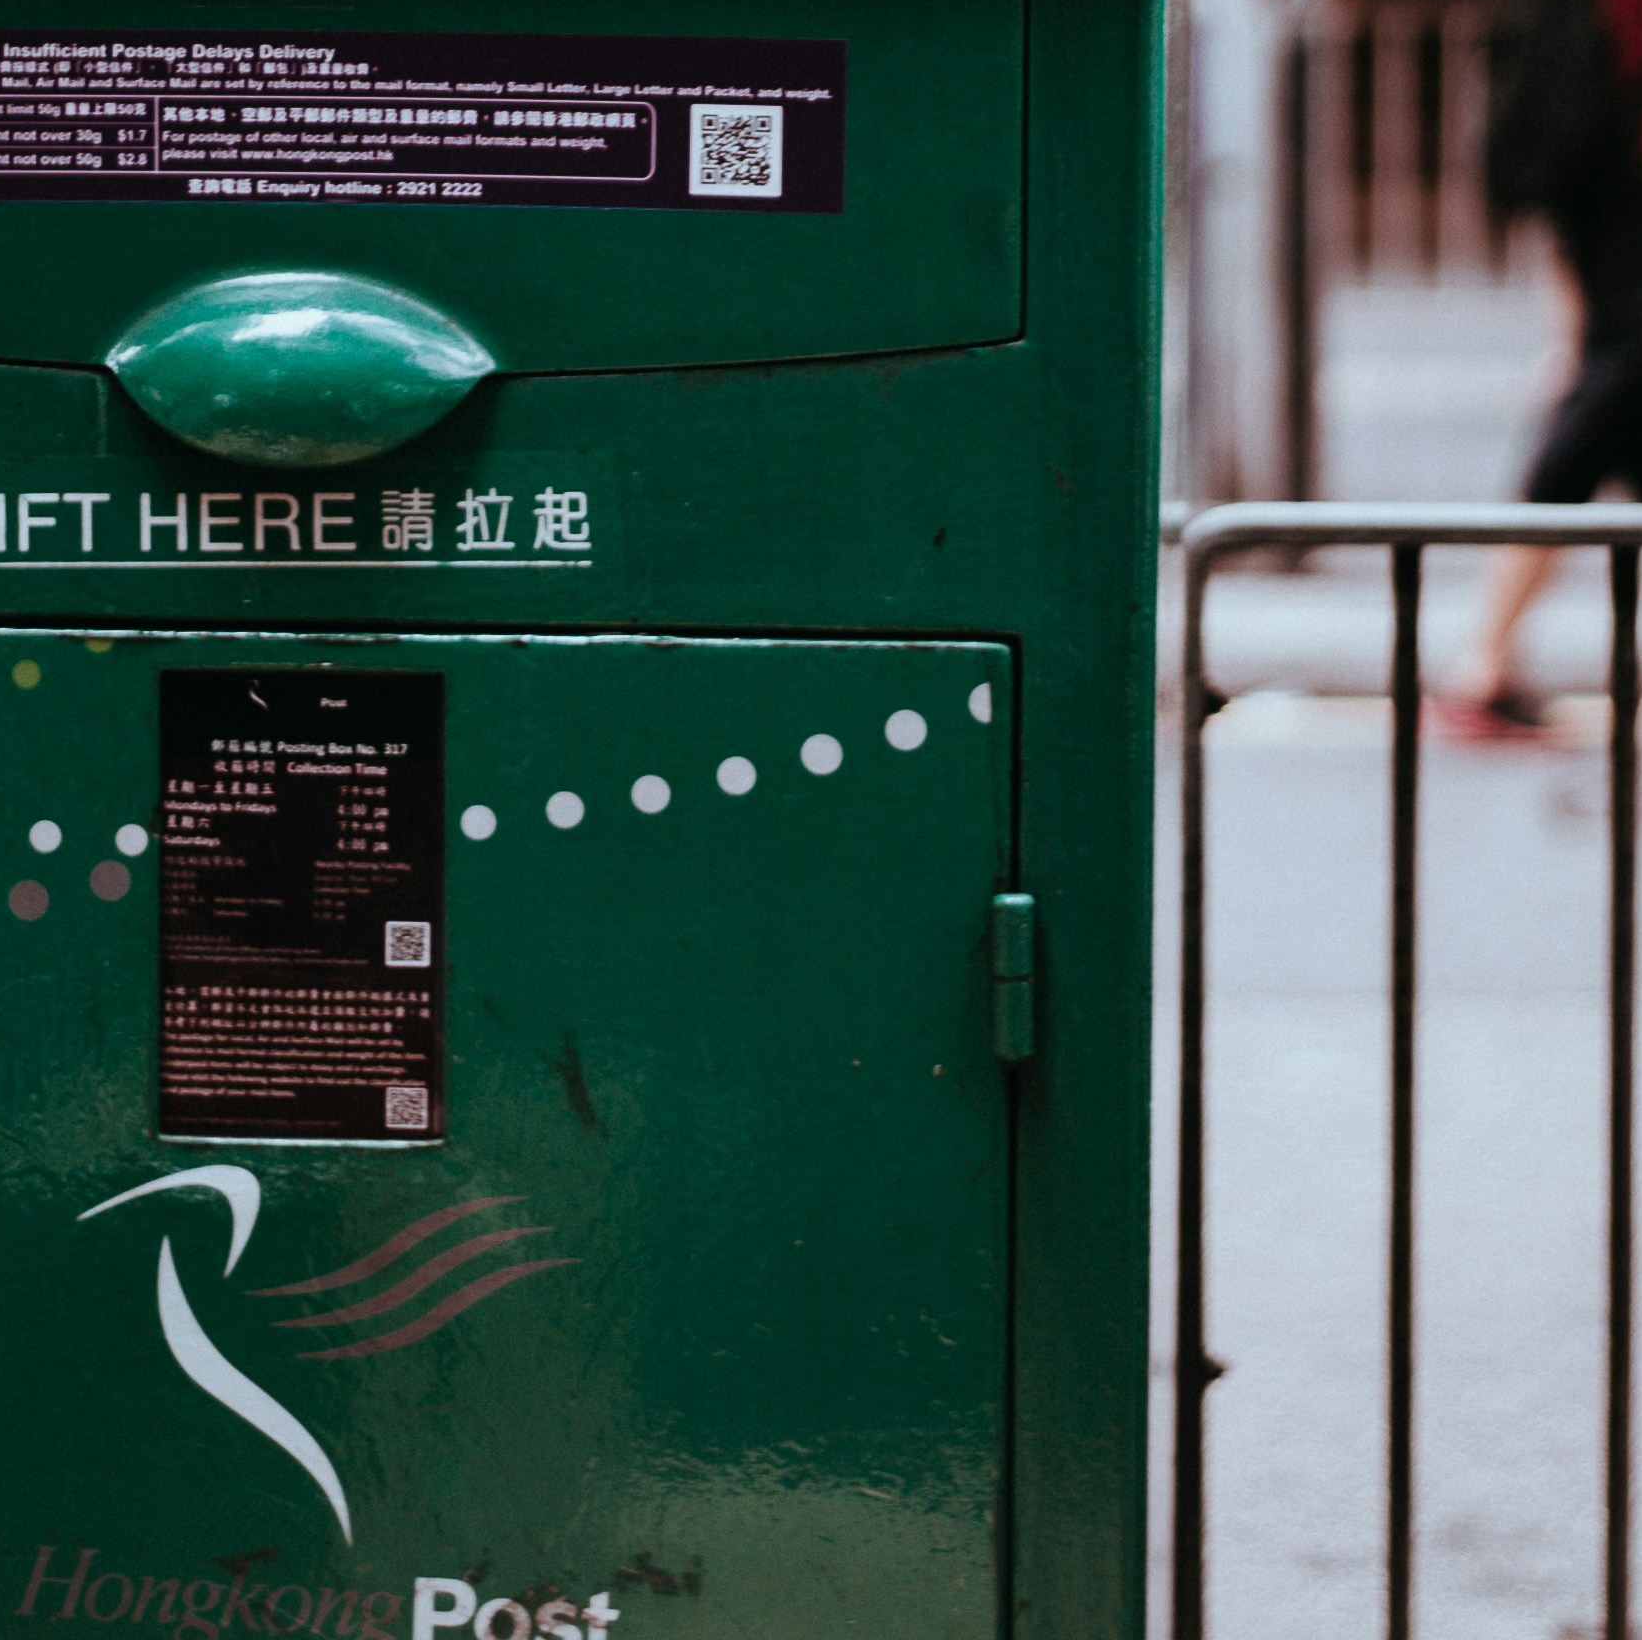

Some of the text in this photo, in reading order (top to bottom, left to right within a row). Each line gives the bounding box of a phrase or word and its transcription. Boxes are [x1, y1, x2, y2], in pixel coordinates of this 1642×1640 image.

[3, 43, 106, 58] Insufficient
[112, 43, 187, 62] Postage
[192, 44, 254, 62] Delays
[259, 44, 336, 62] Delivery
[36, 77, 55, 87] Air
[58, 77, 85, 88] Mail
[88, 77, 113, 88] and
[116, 77, 166, 88] Surface
[169, 78, 197, 88] Mail
[200, 80, 222, 89] are
[225, 79, 245, 89] set
[248, 79, 264, 91] by
[268, 79, 330, 89] reference
[334, 80, 347, 90] to
[350, 79, 371, 90] the
[374, 80, 403, 90] mail
[455, 82, 504, 94] namely
[507, 82, 544, 92] Small
[594, 84, 631, 96] Large
[635, 85, 674, 95] Letter
[677, 86, 702, 95] and
[757, 87, 782, 98] and
[7, 104, 34, 115] limit
[13, 129, 38, 142] not
[40, 131, 72, 142] over
[76, 129, 102, 144] 30g
[117, 128, 148, 143] $1.7
[162, 131, 185, 143] For
[189, 133, 242, 145] postage
[245, 131, 259, 143] of
[262, 132, 297, 143] other
[340, 133, 358, 144] air
[361, 133, 387, 144] and
[390, 133, 440, 145] surface
[443, 134, 472, 145] mail
[475, 134, 527, 147] formats
[530, 135, 557, 147] and
[13, 153, 38, 165] not
[40, 155, 72, 165] over
[117, 152, 148, 166] $2.8
[162, 148, 206, 161] please
[209, 148, 238, 159] visit
[257, 180, 321, 196] Enquiry
[324, 180, 382, 195] hotline
[396, 181, 437, 195] 2921
[442, 182, 483, 196] 2222
[140, 492, 356, 553] HERE
[381, 487, 592, 553] 請拉起
[277, 741, 325, 756] Posting
[328, 742, 353, 755] Box
[356, 743, 379, 755] No.
[383, 743, 408, 755] 317
[287, 762, 352, 774] Collection
[355, 763, 388, 775] Time
[164, 801, 217, 813] Mondays
[219, 802, 232, 812] to
[235, 802, 277, 813] Fridays
[164, 835, 220, 848] Saturdays
[16, 1544, 620, 1640] Hongkong Post
